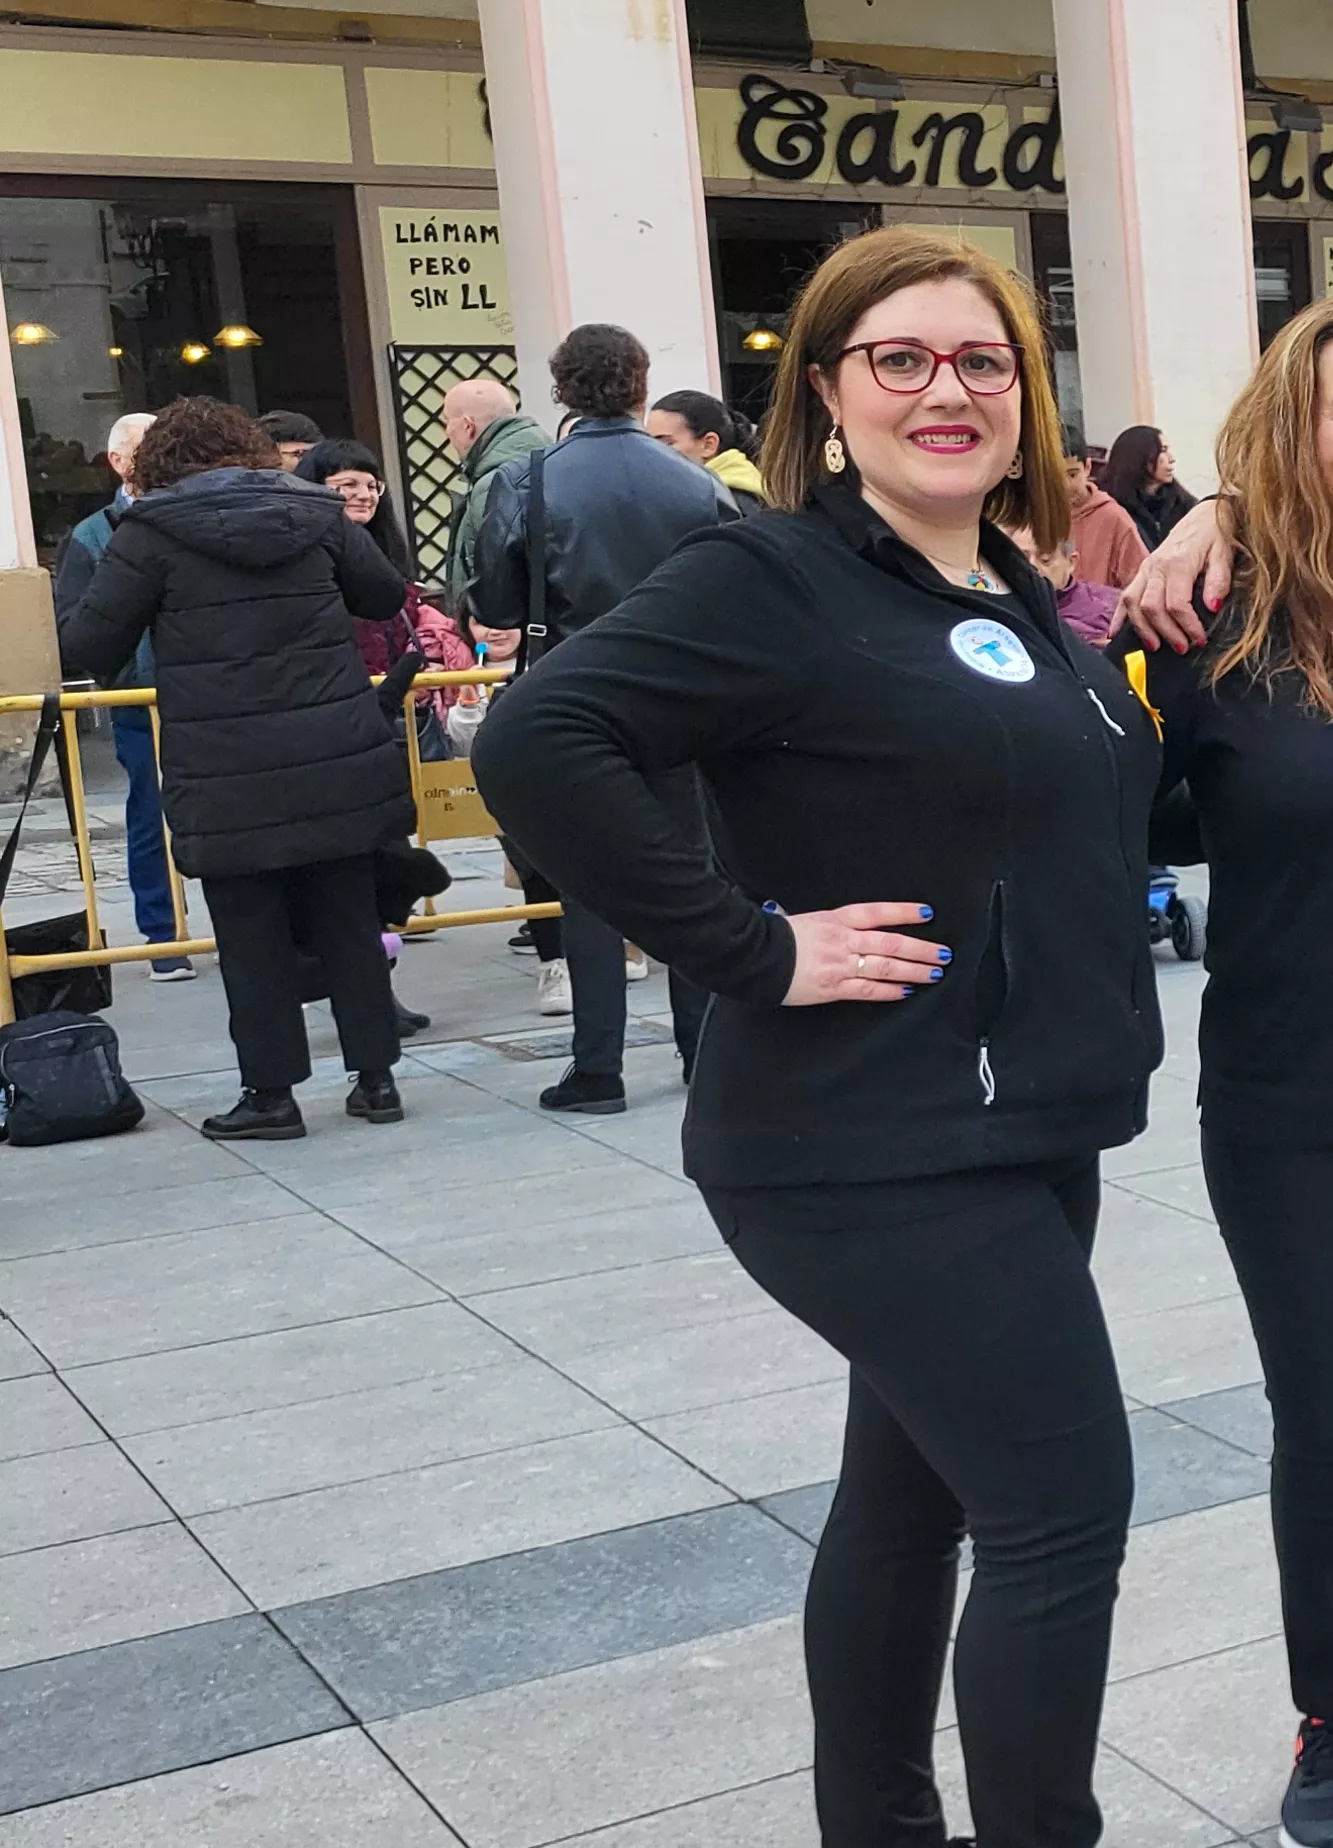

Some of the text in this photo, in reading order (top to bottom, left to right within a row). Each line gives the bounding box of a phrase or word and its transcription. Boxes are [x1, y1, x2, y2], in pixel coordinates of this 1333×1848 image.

[395, 215, 500, 245] LLÁMAM
[409, 256, 471, 275] PERO
[410, 283, 497, 310] SIN LL
